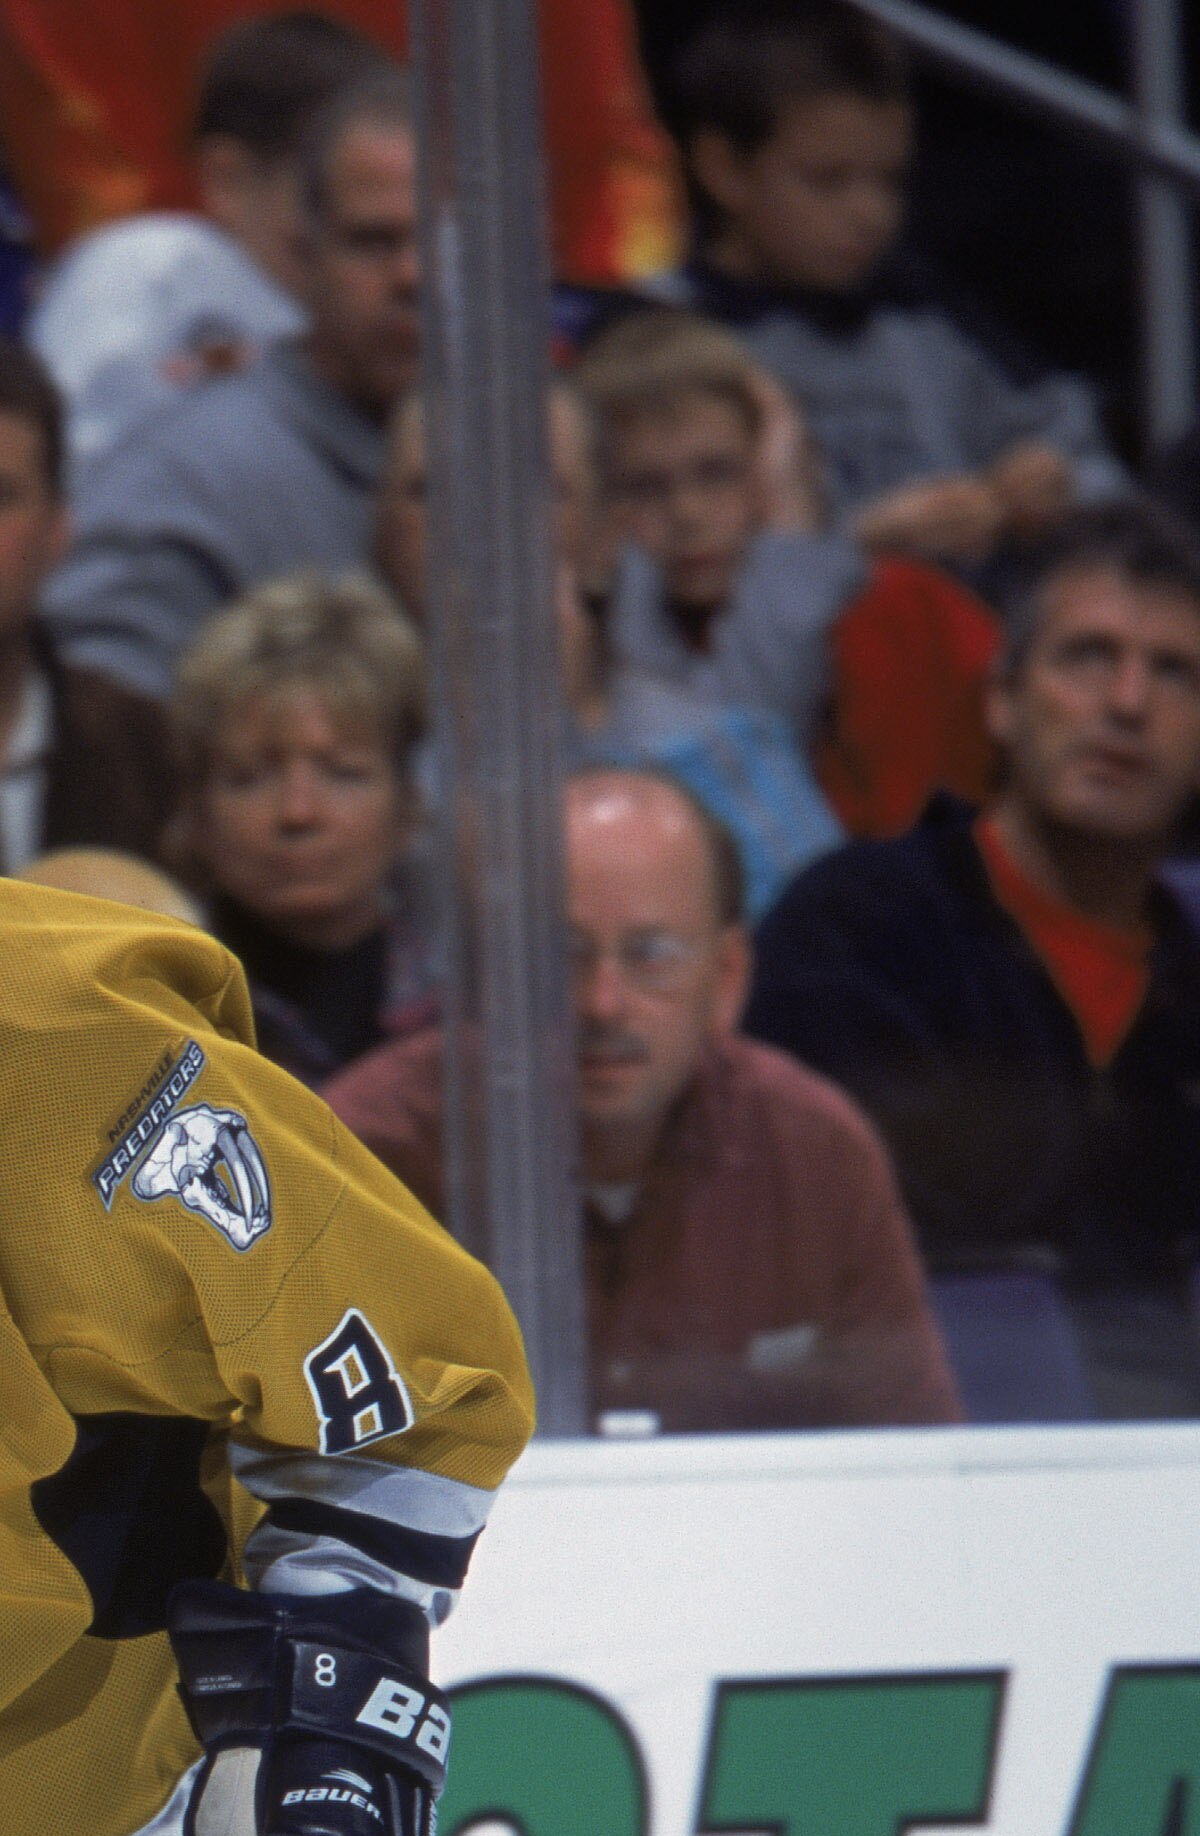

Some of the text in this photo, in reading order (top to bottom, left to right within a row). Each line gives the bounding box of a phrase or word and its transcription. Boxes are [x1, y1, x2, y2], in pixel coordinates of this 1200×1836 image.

[98, 1044, 203, 1196] PREDATORS
[303, 1307, 415, 1456] 8
[315, 1653, 336, 1687] 8
